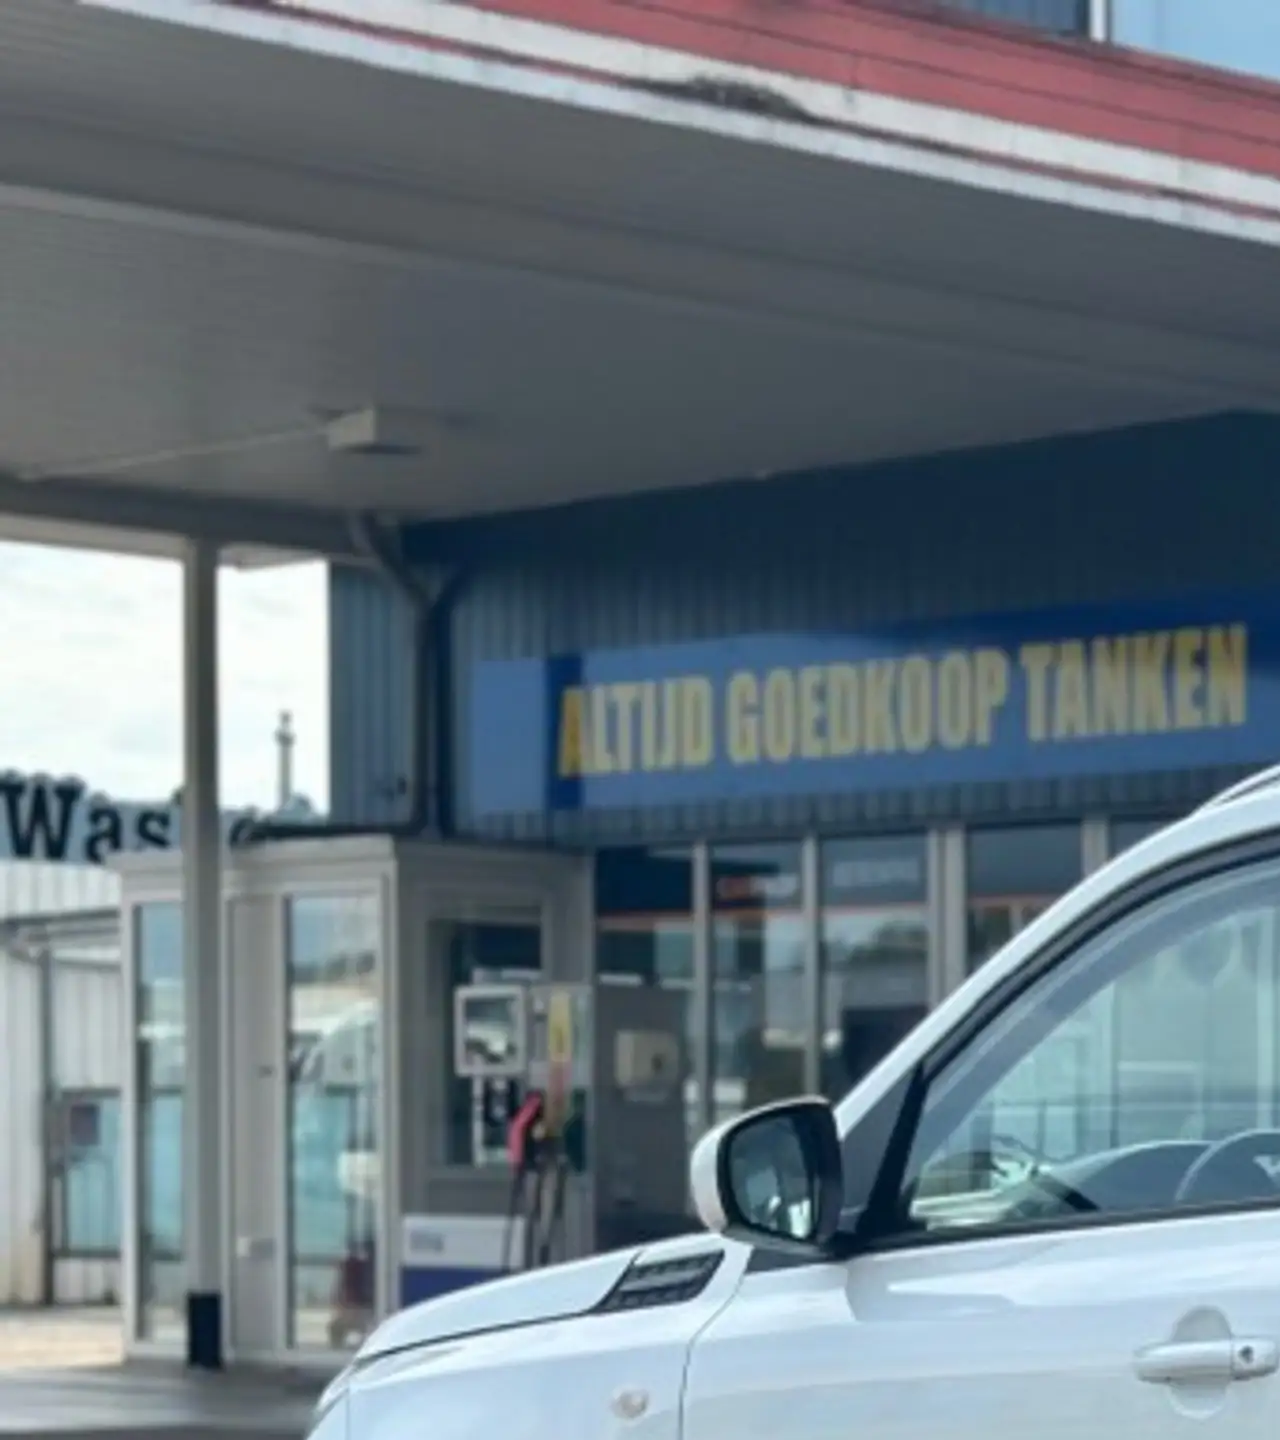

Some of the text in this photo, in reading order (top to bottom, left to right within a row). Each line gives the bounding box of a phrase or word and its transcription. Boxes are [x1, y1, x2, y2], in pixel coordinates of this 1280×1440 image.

[558, 622, 1248, 776] ALTIJD GOEDKOOP TANKEN
